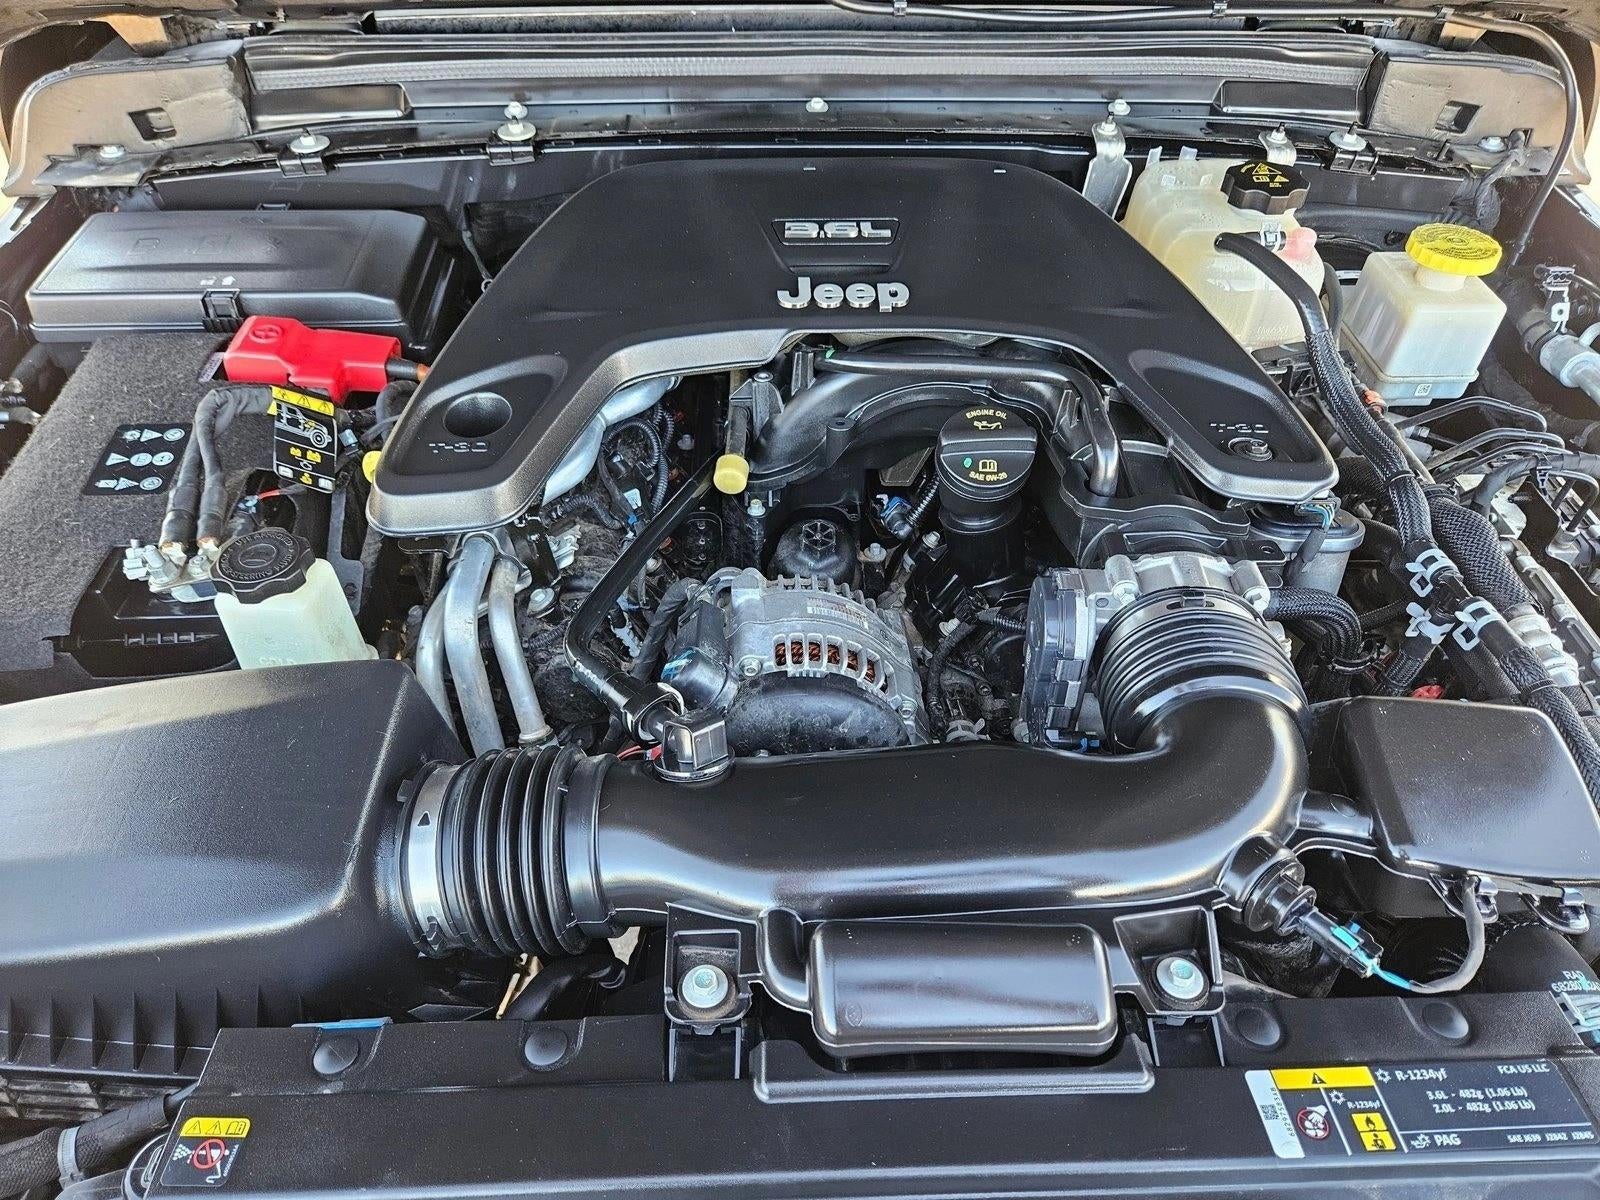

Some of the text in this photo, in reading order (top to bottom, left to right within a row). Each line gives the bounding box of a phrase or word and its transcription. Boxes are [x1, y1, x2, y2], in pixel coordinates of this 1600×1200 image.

[784, 221, 892, 239] 3.6L
[777, 276, 910, 313] Jeep
[965, 409, 1008, 420] ENGINE OIL
[968, 471, 1008, 482] SAE 0W-20
[1395, 1068, 1448, 1082] R-1234yf
[1497, 1063, 1550, 1075] FCA US LLC
[1426, 1090, 1449, 1100] 3.6L
[1459, 1089, 1484, 1100] 482g
[1484, 1087, 1511, 1099] (1.06
[1510, 1086, 1528, 1098] Lb)
[1347, 1100, 1380, 1109] R-1234yf
[1432, 1103, 1456, 1114] 2.0L
[1466, 1101, 1492, 1113] 482g
[1491, 1100, 1518, 1112] (1.06
[1517, 1099, 1536, 1111] Lb)
[1433, 1133, 1462, 1146] PAG
[1507, 1134, 1524, 1143] SAE
